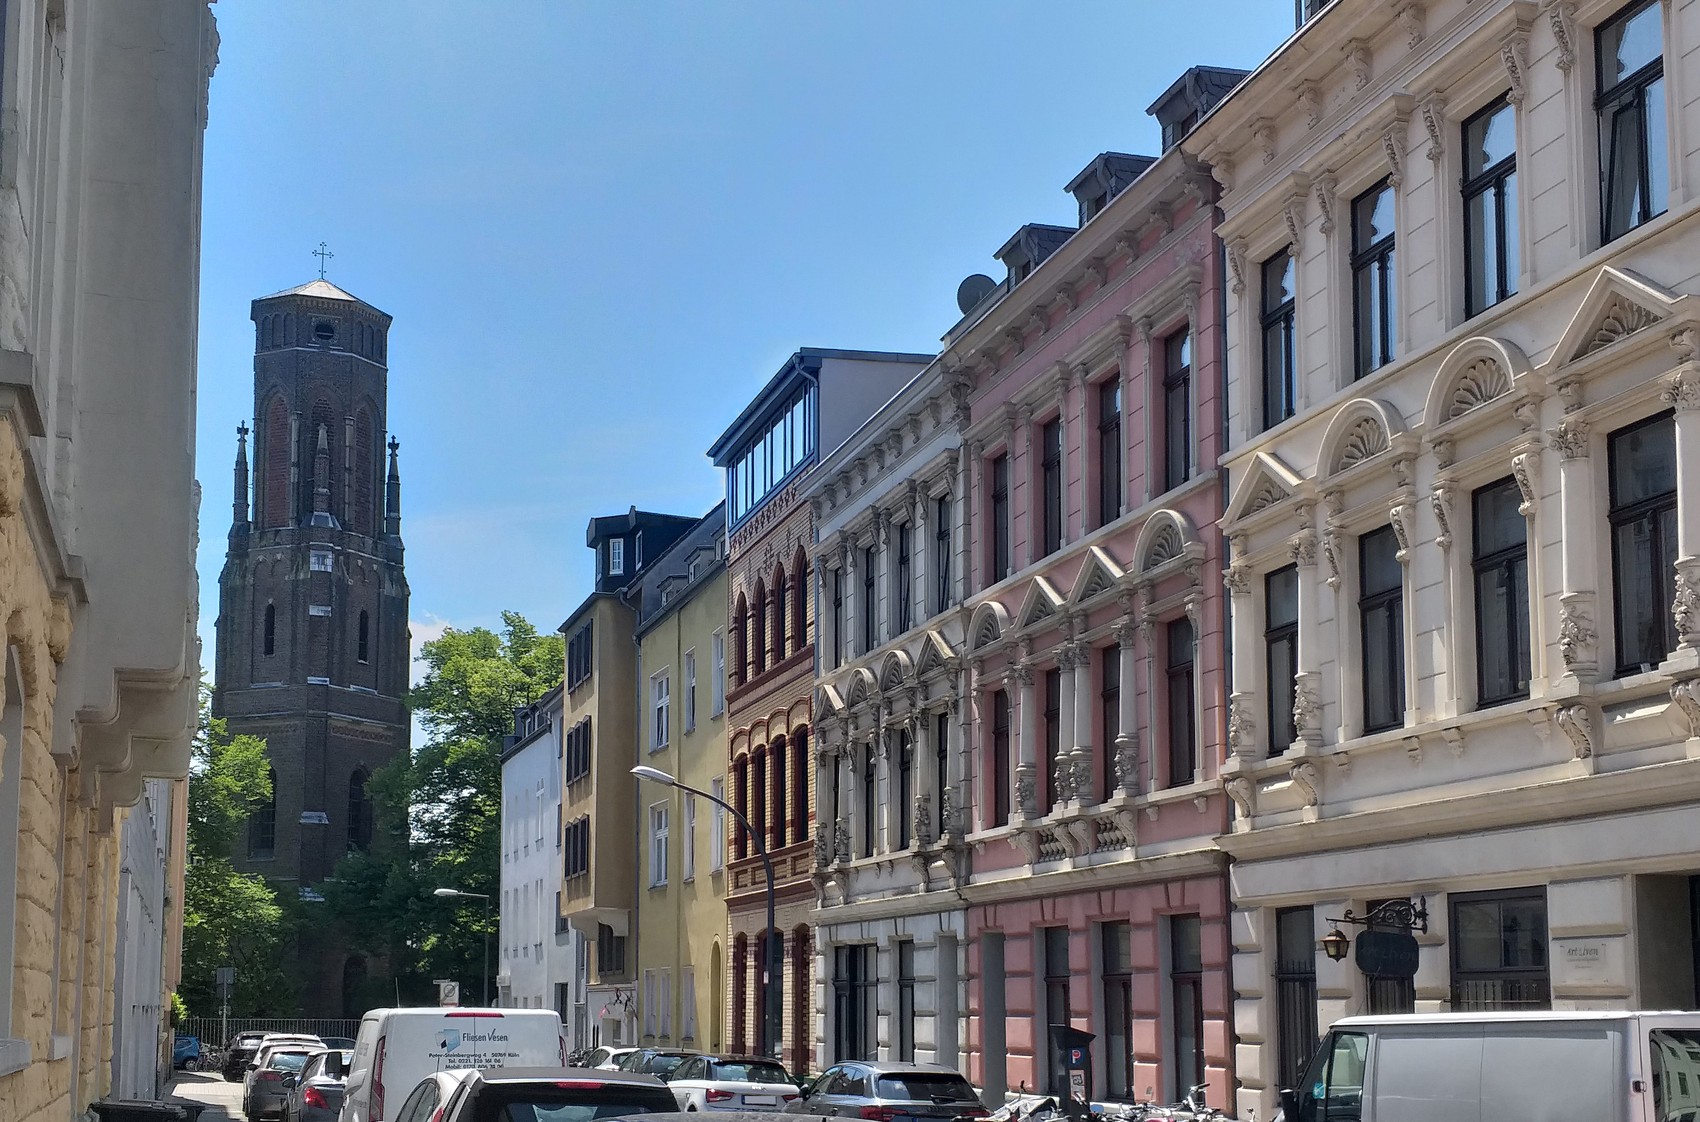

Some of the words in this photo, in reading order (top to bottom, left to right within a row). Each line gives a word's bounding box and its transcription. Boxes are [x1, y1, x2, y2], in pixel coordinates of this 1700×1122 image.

[463, 1032, 487, 1042] Fliesen
[487, 1028, 508, 1042] Vesen
[1072, 1049, 1081, 1064] P
